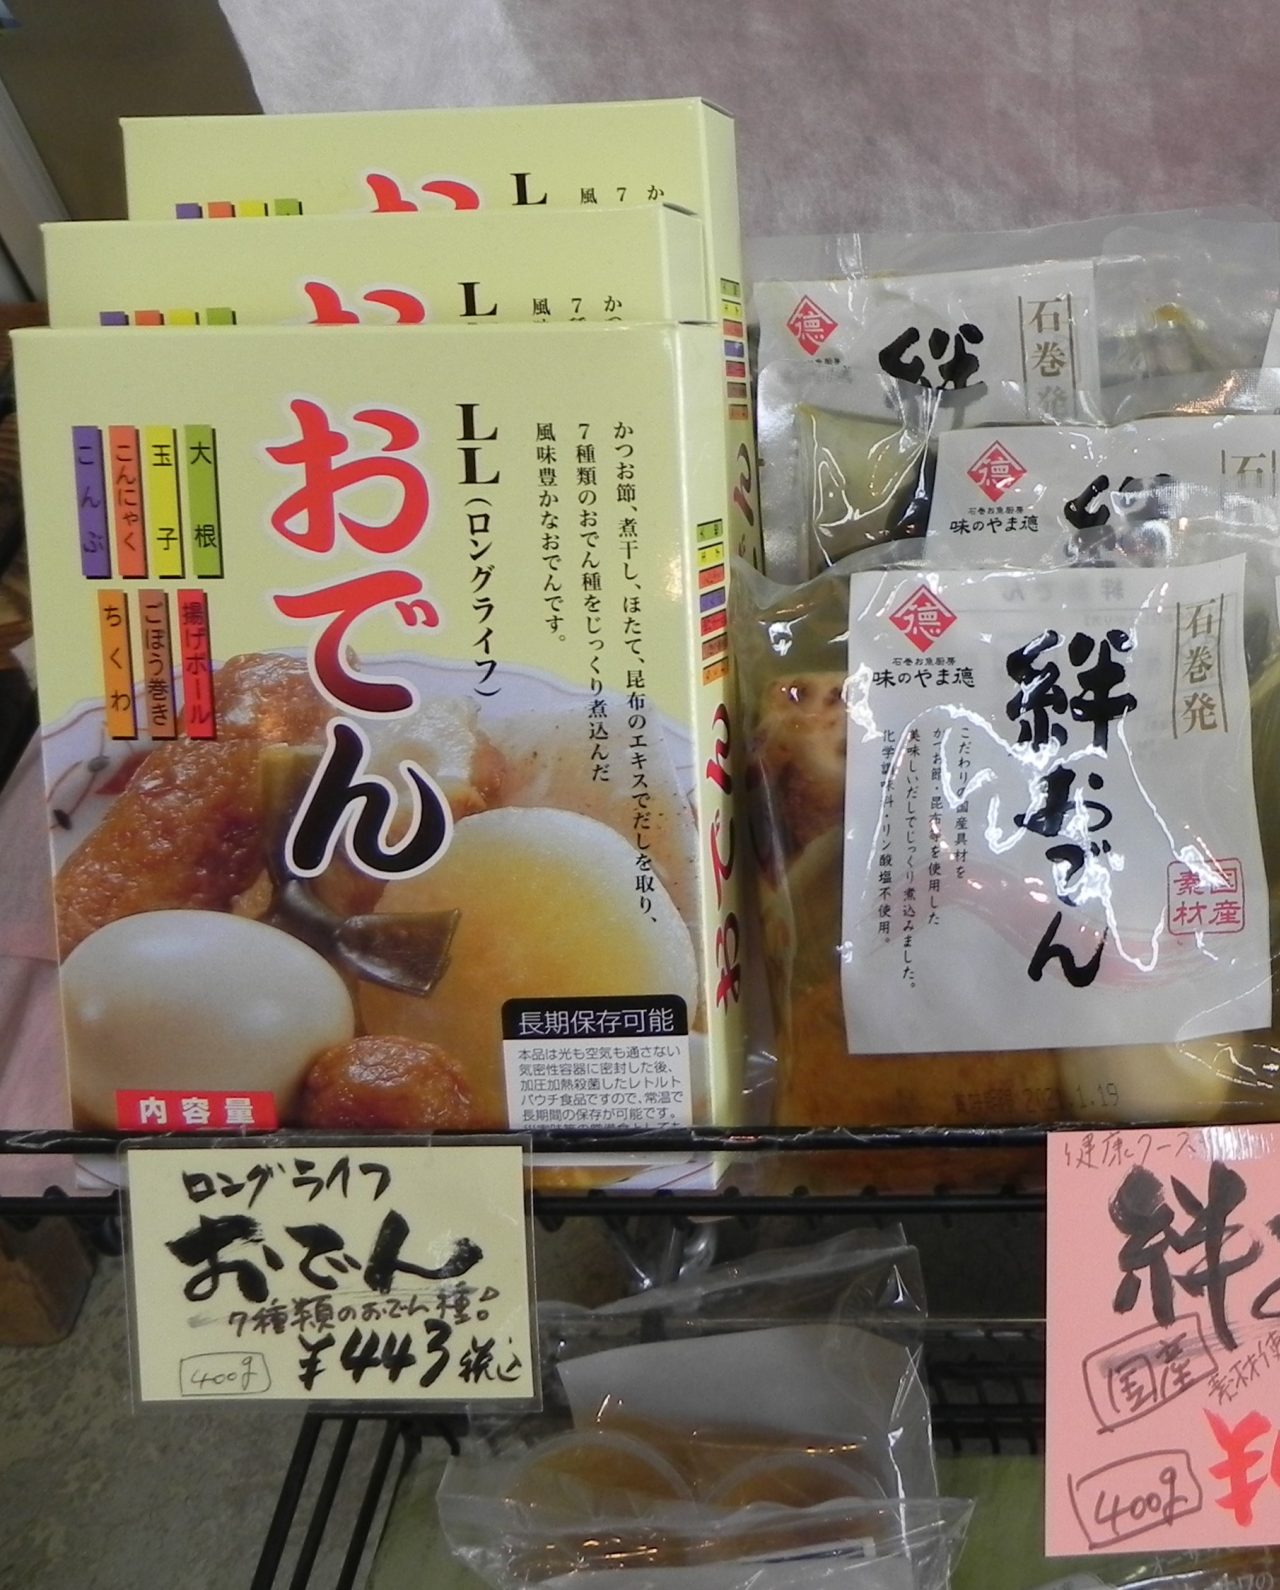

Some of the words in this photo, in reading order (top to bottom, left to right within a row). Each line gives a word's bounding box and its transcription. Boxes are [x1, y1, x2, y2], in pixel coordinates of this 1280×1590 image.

[114, 443, 138, 551] こんにゃく
[152, 443, 178, 550] 玉子
[190, 441, 218, 549] 大根
[536, 423, 566, 642] 風味豊かなおでんです。
[265, 399, 453, 877] おでん
[576, 423, 609, 781] 7種類のおでん種をじっくり煮込んだ
[104, 605, 131, 711] ちくわ
[182, 602, 211, 724] 揚げボール
[1181, 597, 1218, 735] 石巻発
[1006, 629, 1137, 987] 絆おでん
[518, 1046, 681, 1061] 本品は光も空気も通さない
[519, 1008, 674, 1035] 長期保存可能
[519, 1061, 673, 1076] 気密性容器に密封した後、
[139, 1097, 255, 1125] 内容量
[521, 1076, 681, 1091] 加圧加熱殺菌したレトルト
[521, 1091, 683, 1106] パウチ食品ですので、常温で
[523, 1107, 675, 1122] 長期間の保存が可能です。
[183, 1156, 390, 1207] ロングライフ
[165, 1209, 484, 1301] おでん
[1095, 1466, 1188, 1536] 400g
